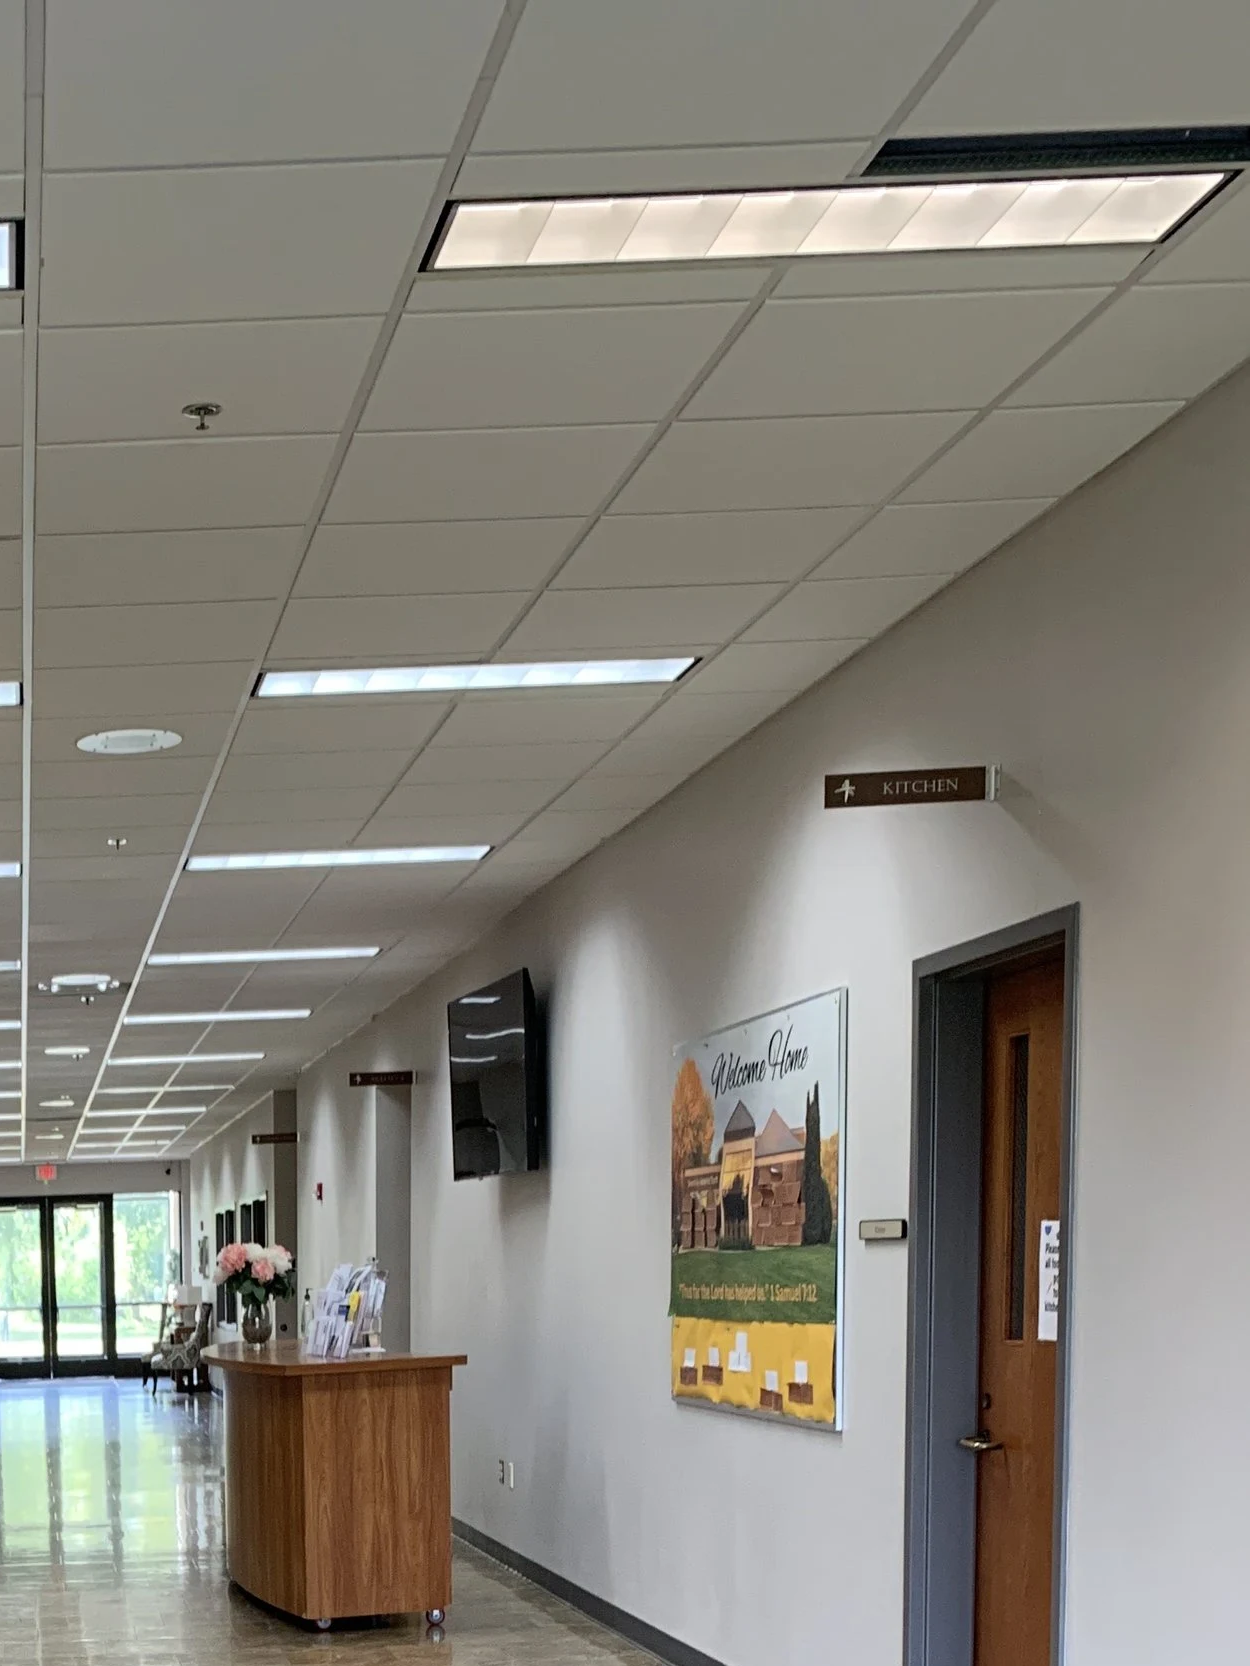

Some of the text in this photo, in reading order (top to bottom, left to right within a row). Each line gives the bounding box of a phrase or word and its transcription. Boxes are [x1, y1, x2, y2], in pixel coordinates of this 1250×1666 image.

[881, 778, 958, 795] KITCHEN
[711, 1023, 809, 1099] Welcome Home
[711, 1282, 723, 1300] Lord
[723, 1283, 734, 1299] has
[735, 1283, 756, 1305] helped
[775, 1283, 801, 1302] Samuel
